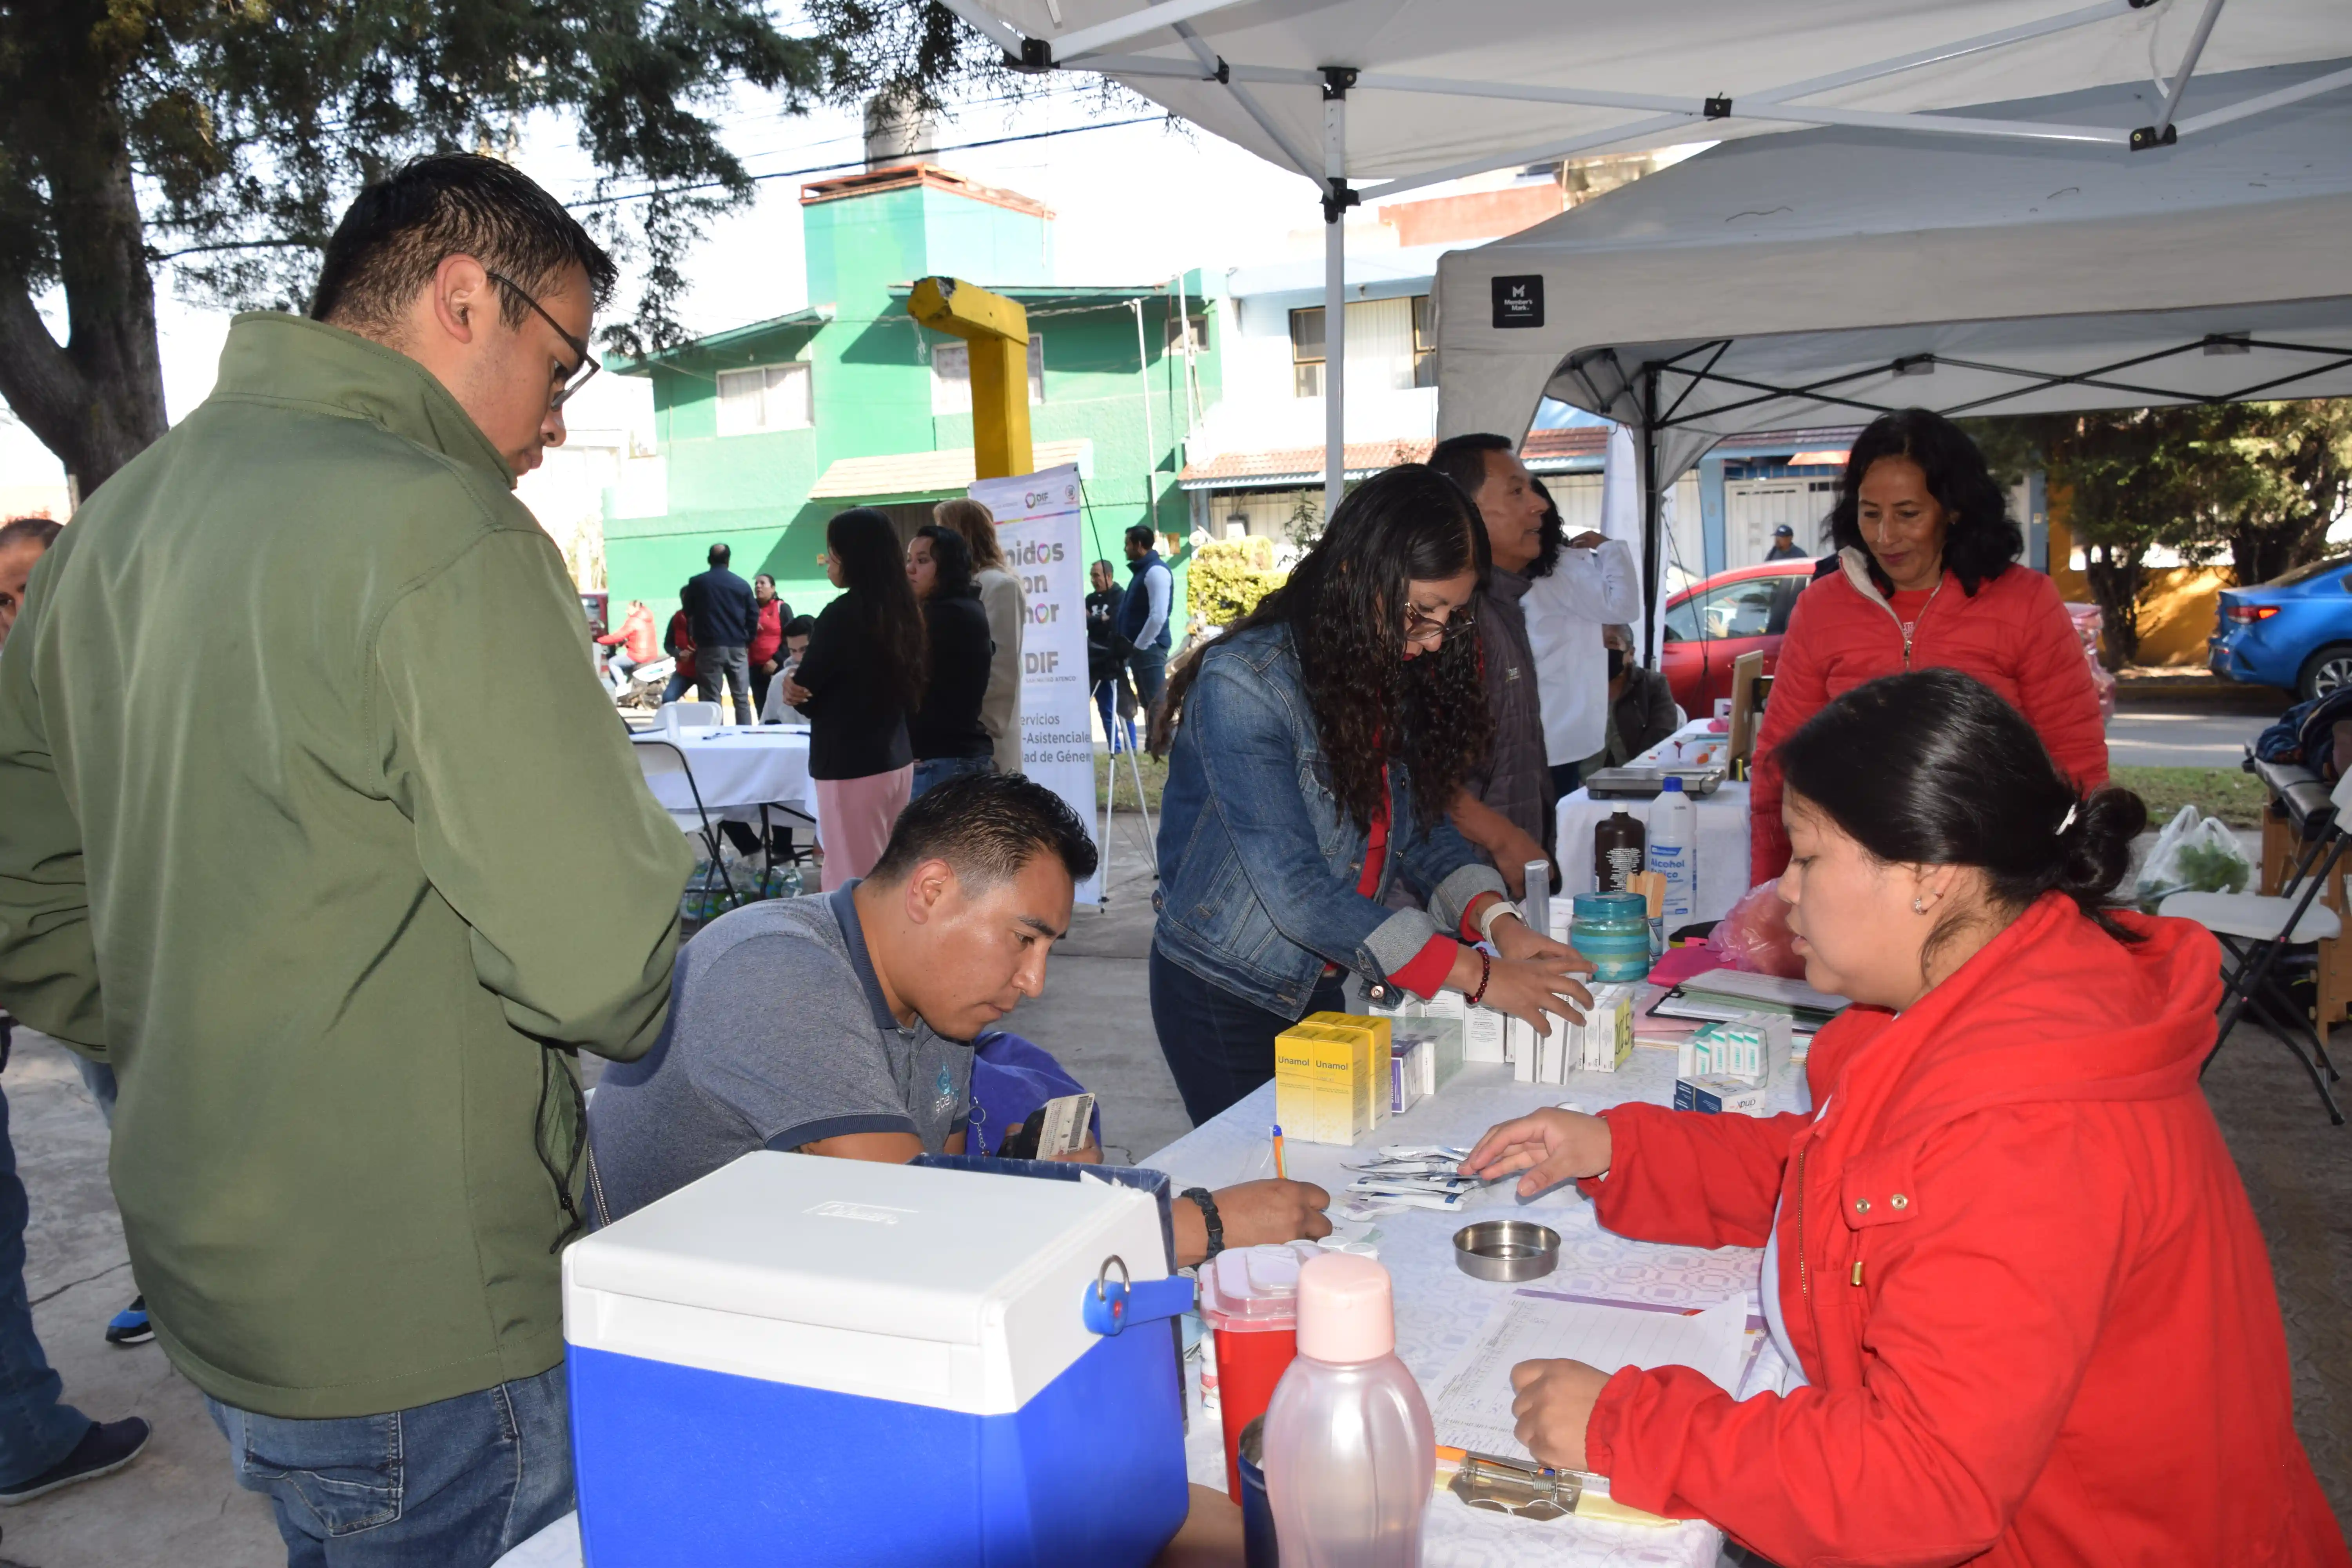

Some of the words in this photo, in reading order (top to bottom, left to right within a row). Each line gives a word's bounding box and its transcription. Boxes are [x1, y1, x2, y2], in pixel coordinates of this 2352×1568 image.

[1036, 492, 1049, 502] DIF
[1005, 540, 1065, 566] nidos
[1023, 574, 1048, 594] on
[1025, 651, 1058, 674] DIF
[1020, 713, 1060, 725] ervicios
[1022, 731, 1091, 744] -Asistenciale
[1022, 750, 1037, 762] ad
[1040, 750, 1053, 763] de
[1651, 858, 1685, 868] Alcohol
[1278, 1055, 1310, 1067] Unamol
[1316, 1060, 1348, 1071] Unamol
